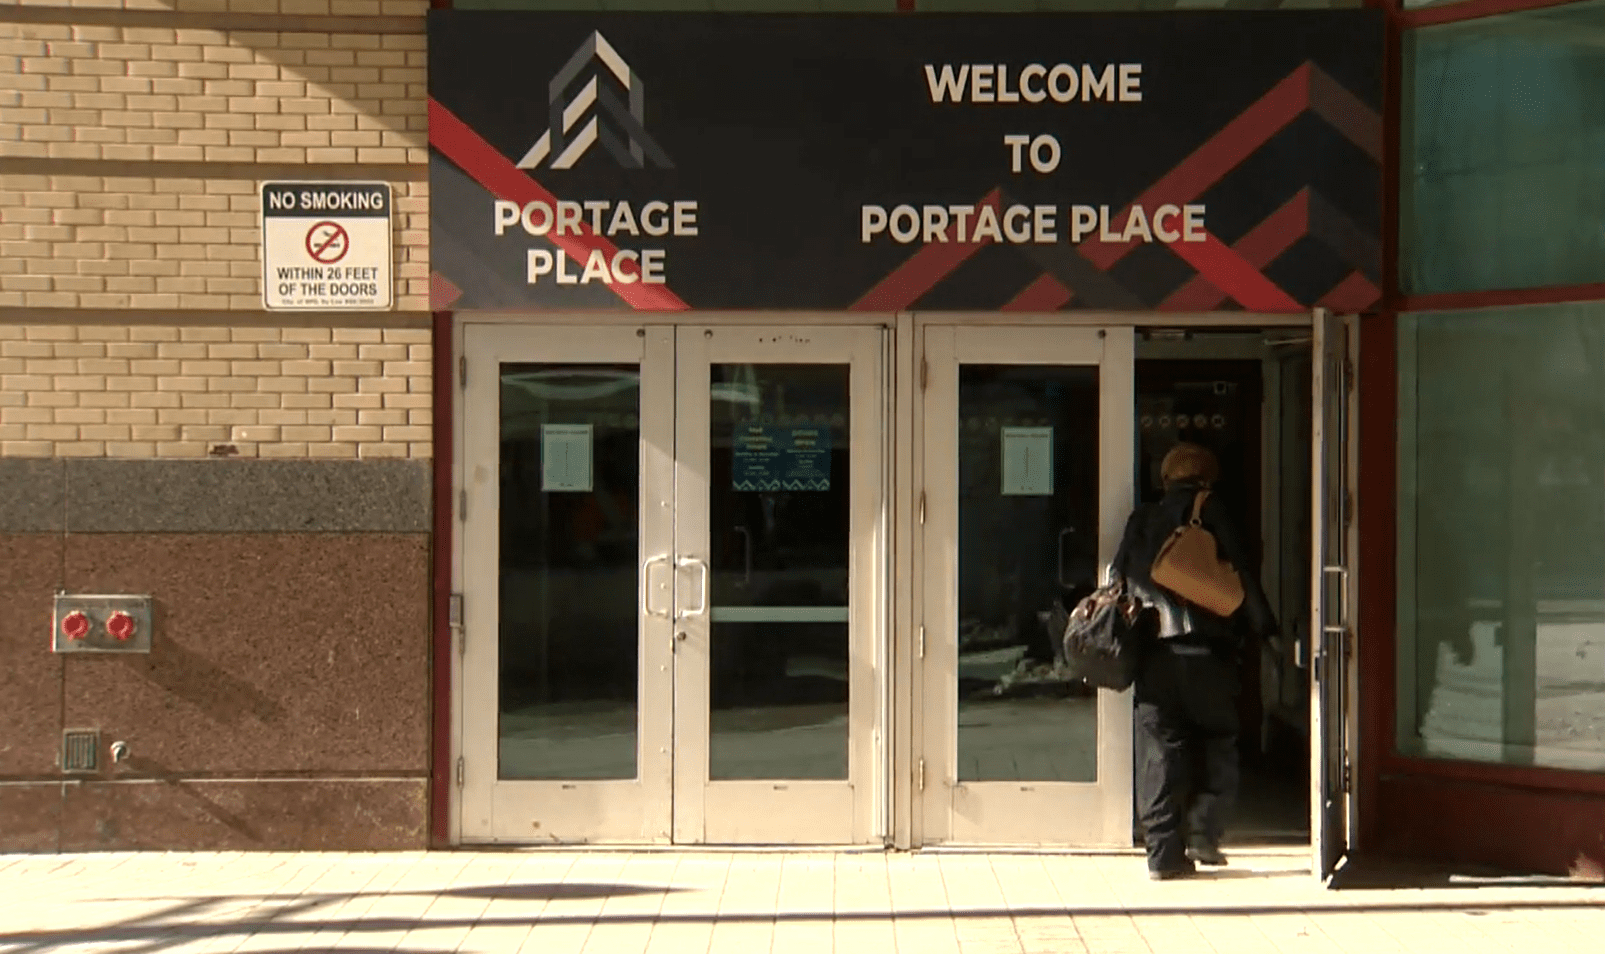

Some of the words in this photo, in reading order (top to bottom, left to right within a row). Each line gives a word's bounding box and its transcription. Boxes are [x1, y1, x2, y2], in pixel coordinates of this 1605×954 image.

[924, 63, 1143, 104] WELCOME
[1003, 134, 1062, 174] TO
[269, 191, 295, 210] NO
[300, 191, 384, 210] SMOKING
[493, 200, 699, 237] PORTAGE
[861, 204, 1058, 244] PORTAGE
[1071, 204, 1207, 244] PLACE
[276, 267, 324, 280] WITHIN
[327, 267, 342, 280] 26
[345, 267, 378, 280] FEET
[526, 249, 667, 285] PLACE
[278, 283, 297, 296] OF
[301, 283, 326, 296] THE
[330, 283, 377, 296] DOORS
